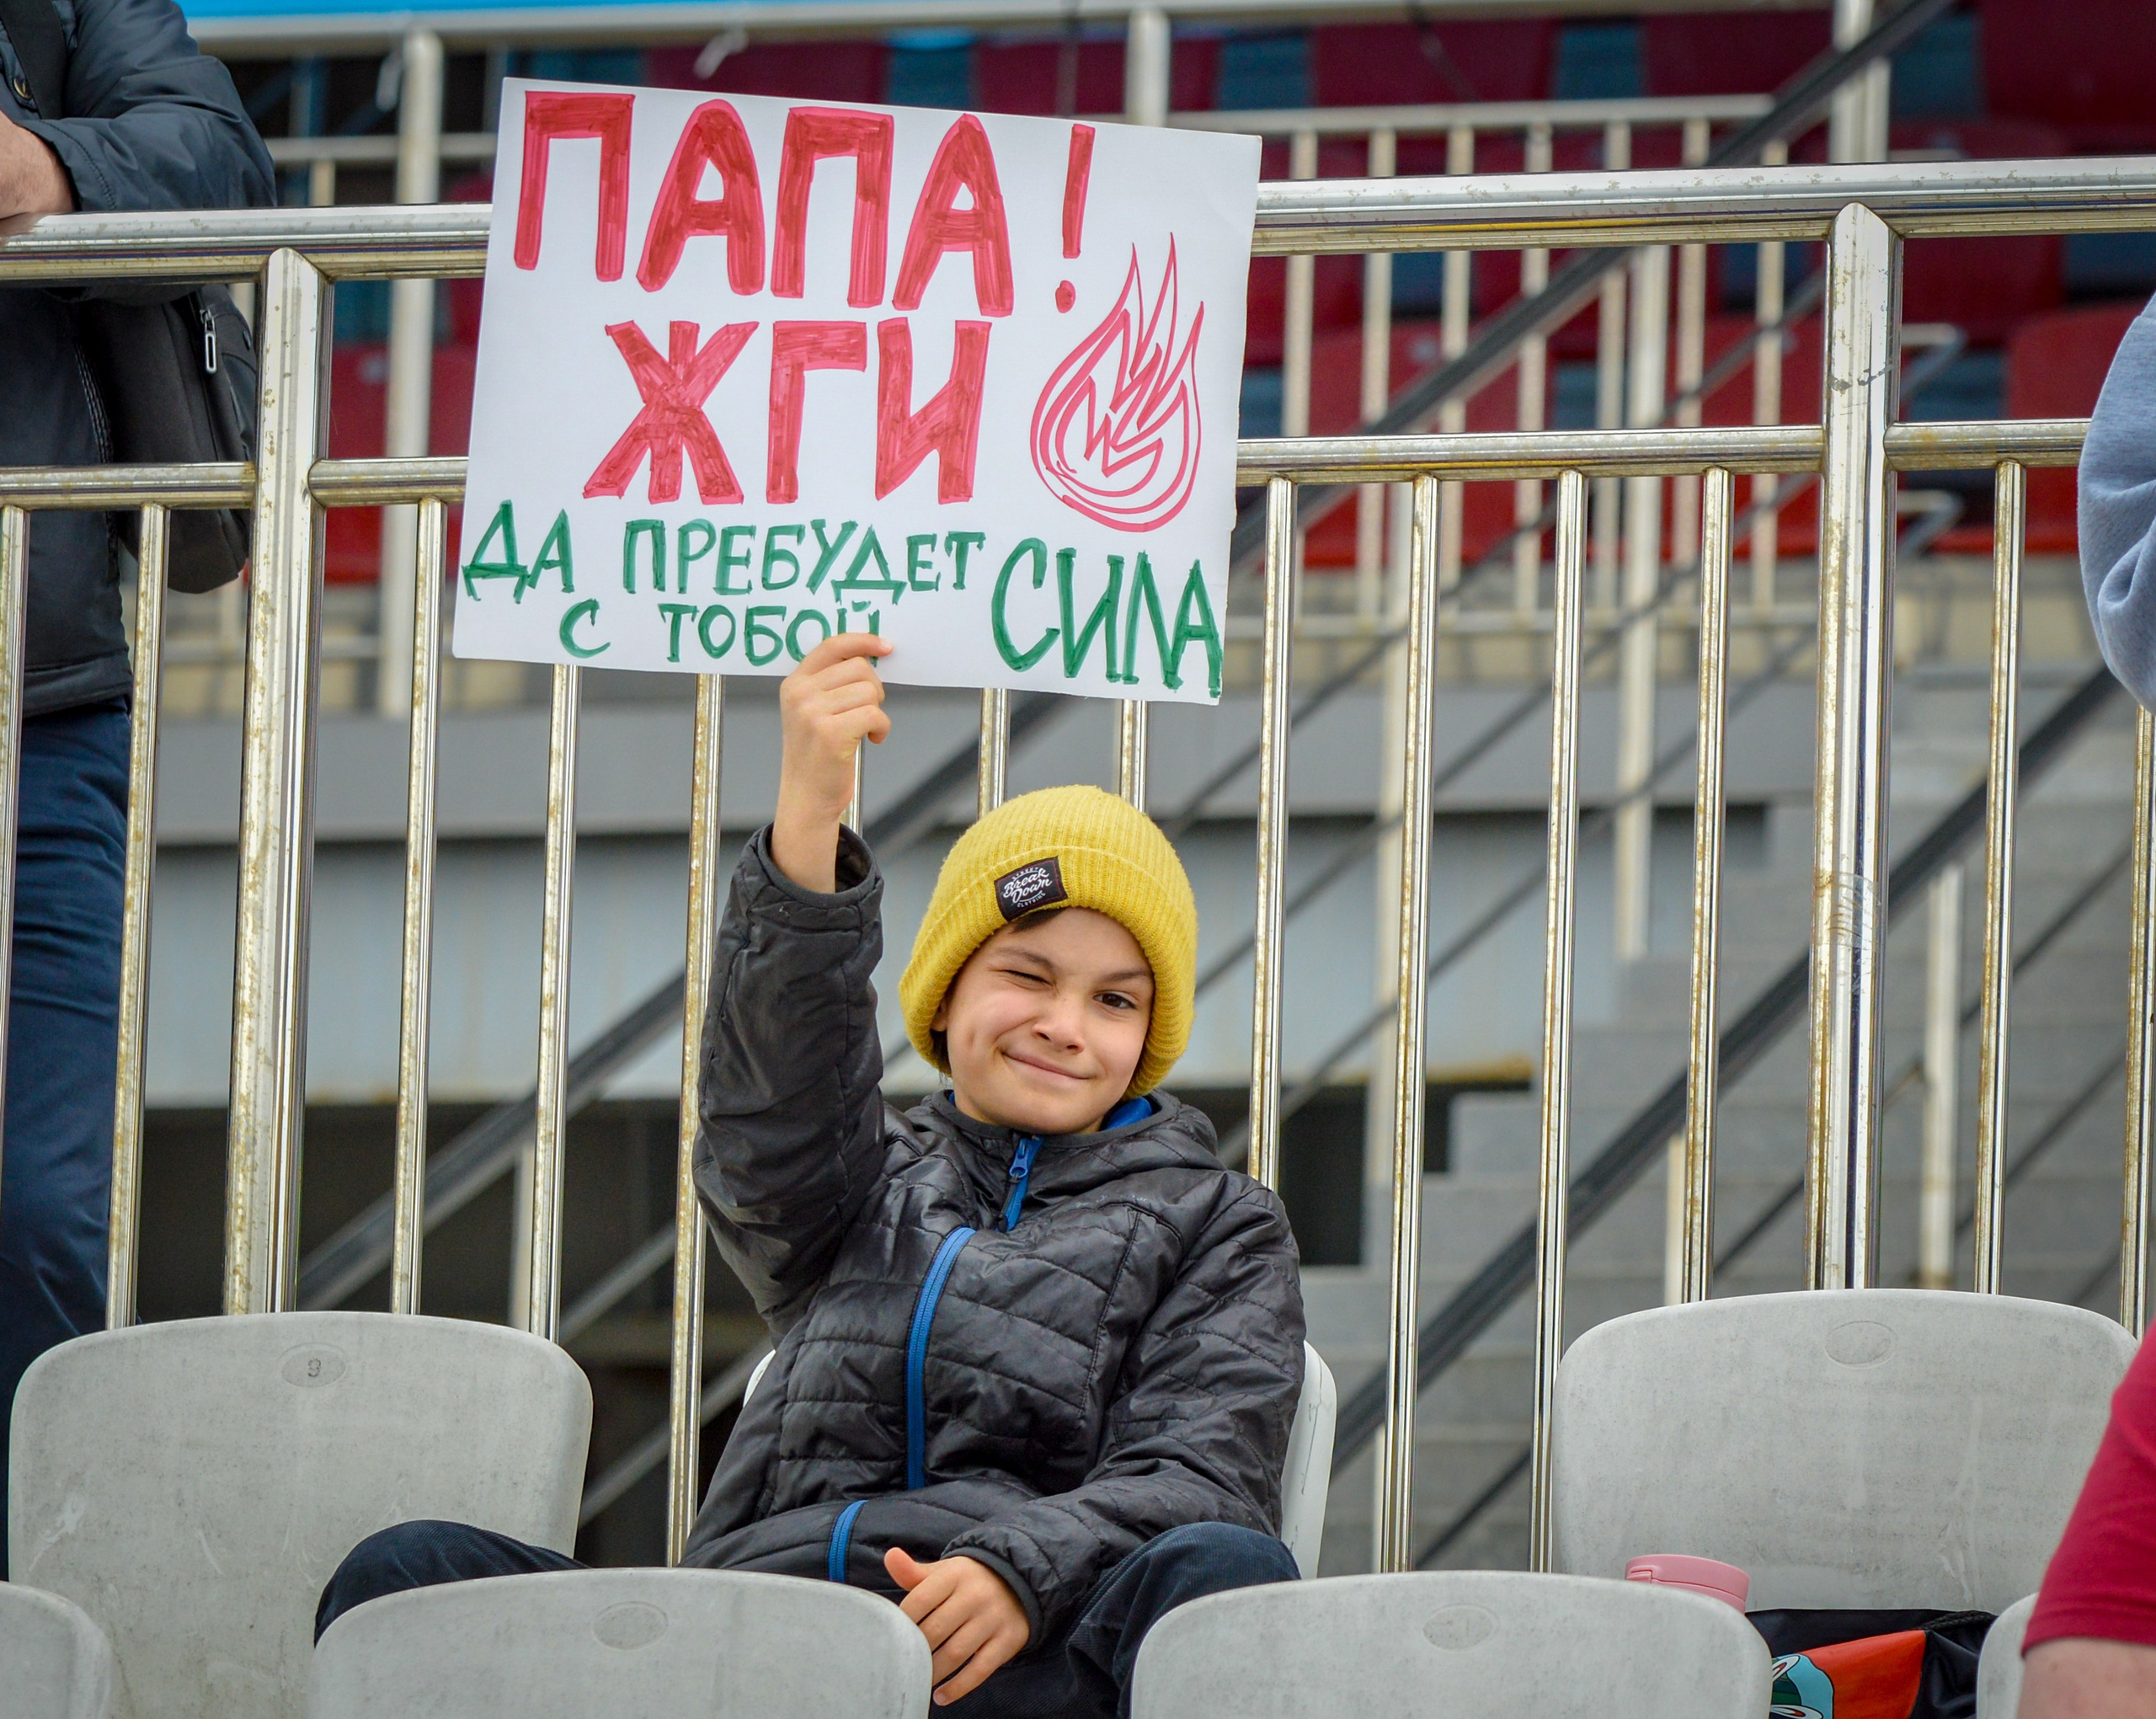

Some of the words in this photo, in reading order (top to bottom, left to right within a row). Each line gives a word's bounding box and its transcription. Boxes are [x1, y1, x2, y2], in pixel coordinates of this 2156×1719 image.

[582, 317, 993, 505] ЖГИ
[462, 499, 575, 604] ДА
[623, 518, 986, 605] ПРЕБУДЕТ
[558, 597, 611, 659] С
[991, 537, 1224, 699] СИЛА
[1002, 867, 1050, 899] Break
[1011, 878, 1053, 904] Down
[1017, 892, 1046, 908] CLOTHING
